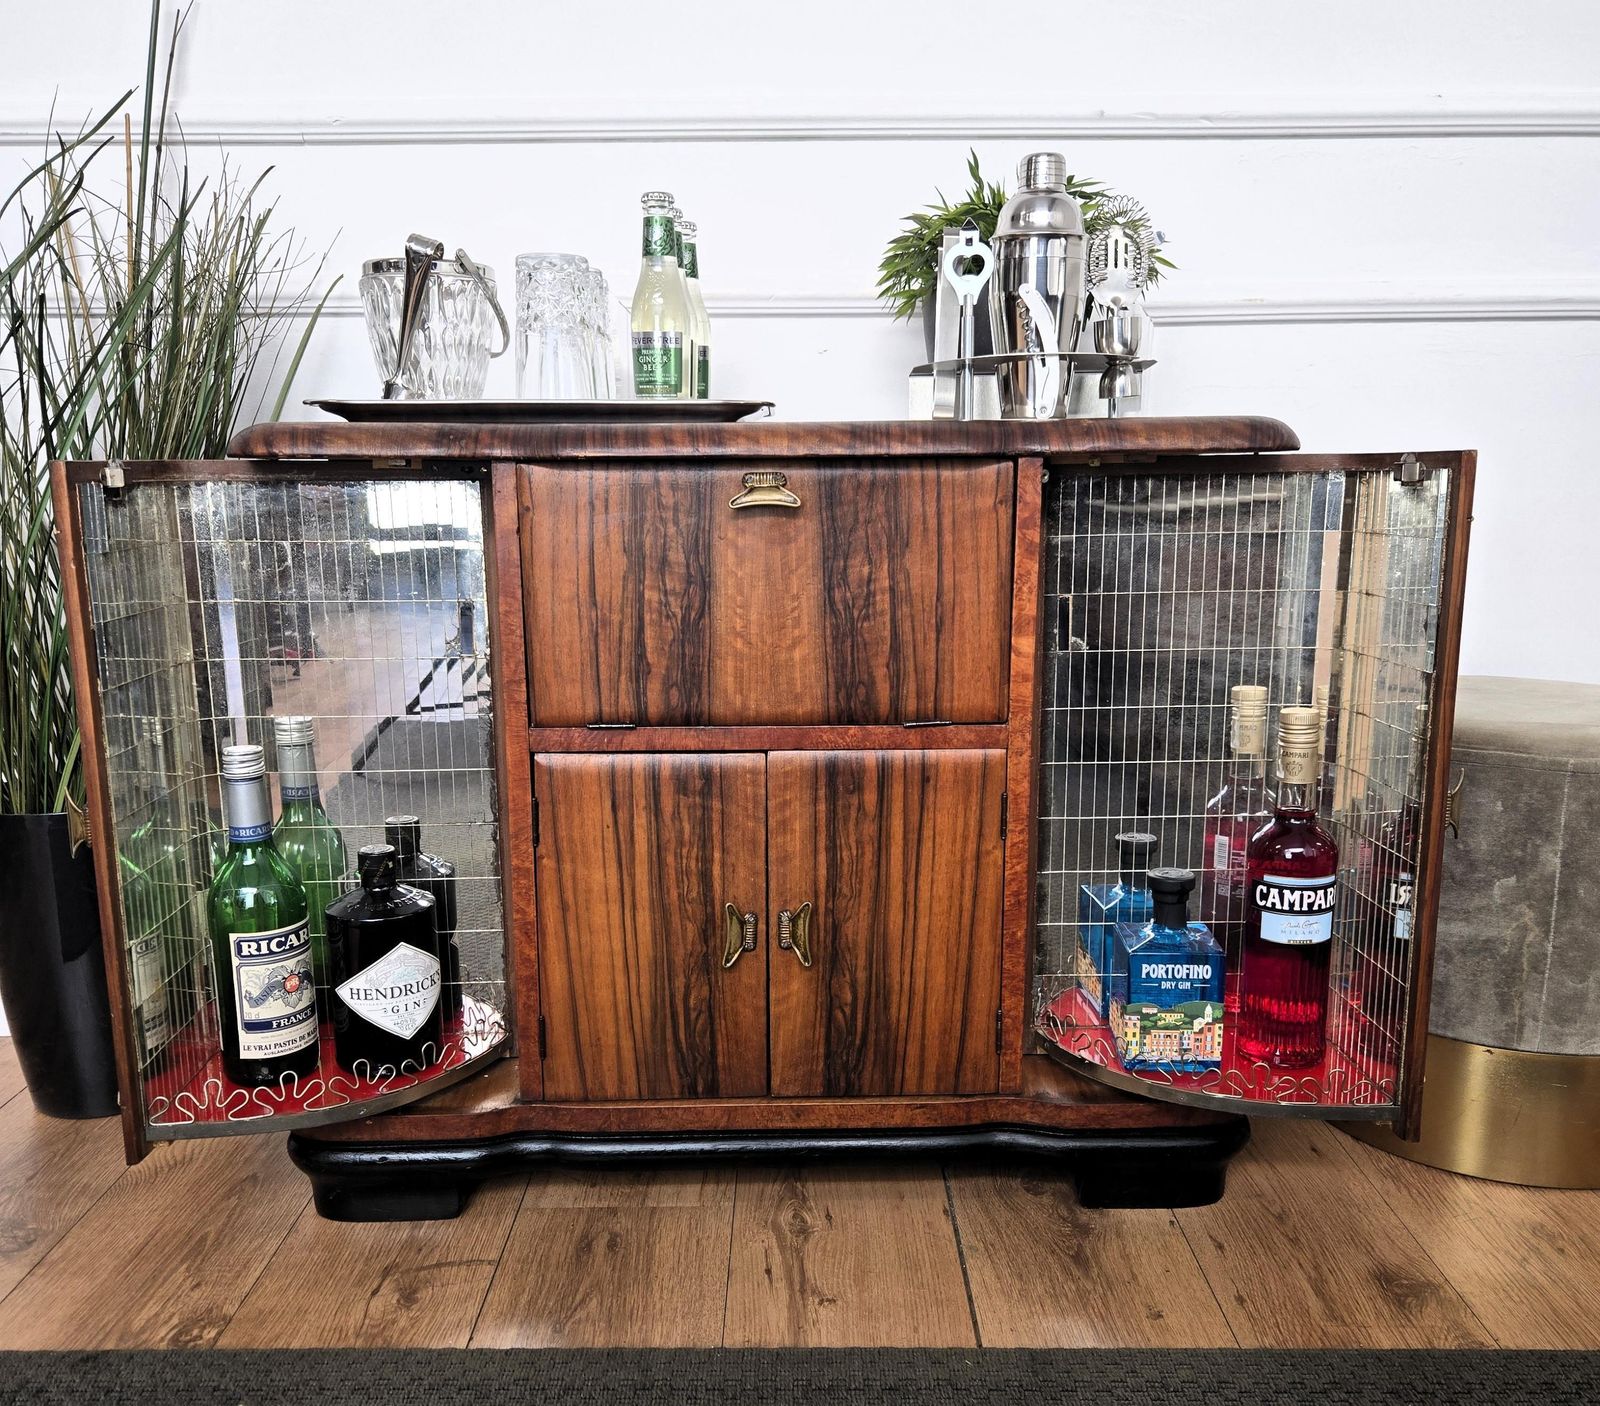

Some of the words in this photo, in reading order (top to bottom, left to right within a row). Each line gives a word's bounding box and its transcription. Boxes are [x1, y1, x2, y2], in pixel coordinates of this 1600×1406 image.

[240, 923, 311, 956] RICAR
[1141, 963, 1212, 980] PORTOFINO
[1161, 981, 1176, 990] DRY
[1177, 981, 1191, 990] GIN
[391, 1000, 421, 1014] GIN
[271, 1007, 312, 1029] FRANCE
[253, 1043, 272, 1051] VRAI
[273, 1037, 297, 1049] PASTIS
[298, 1033, 306, 1042] DE
